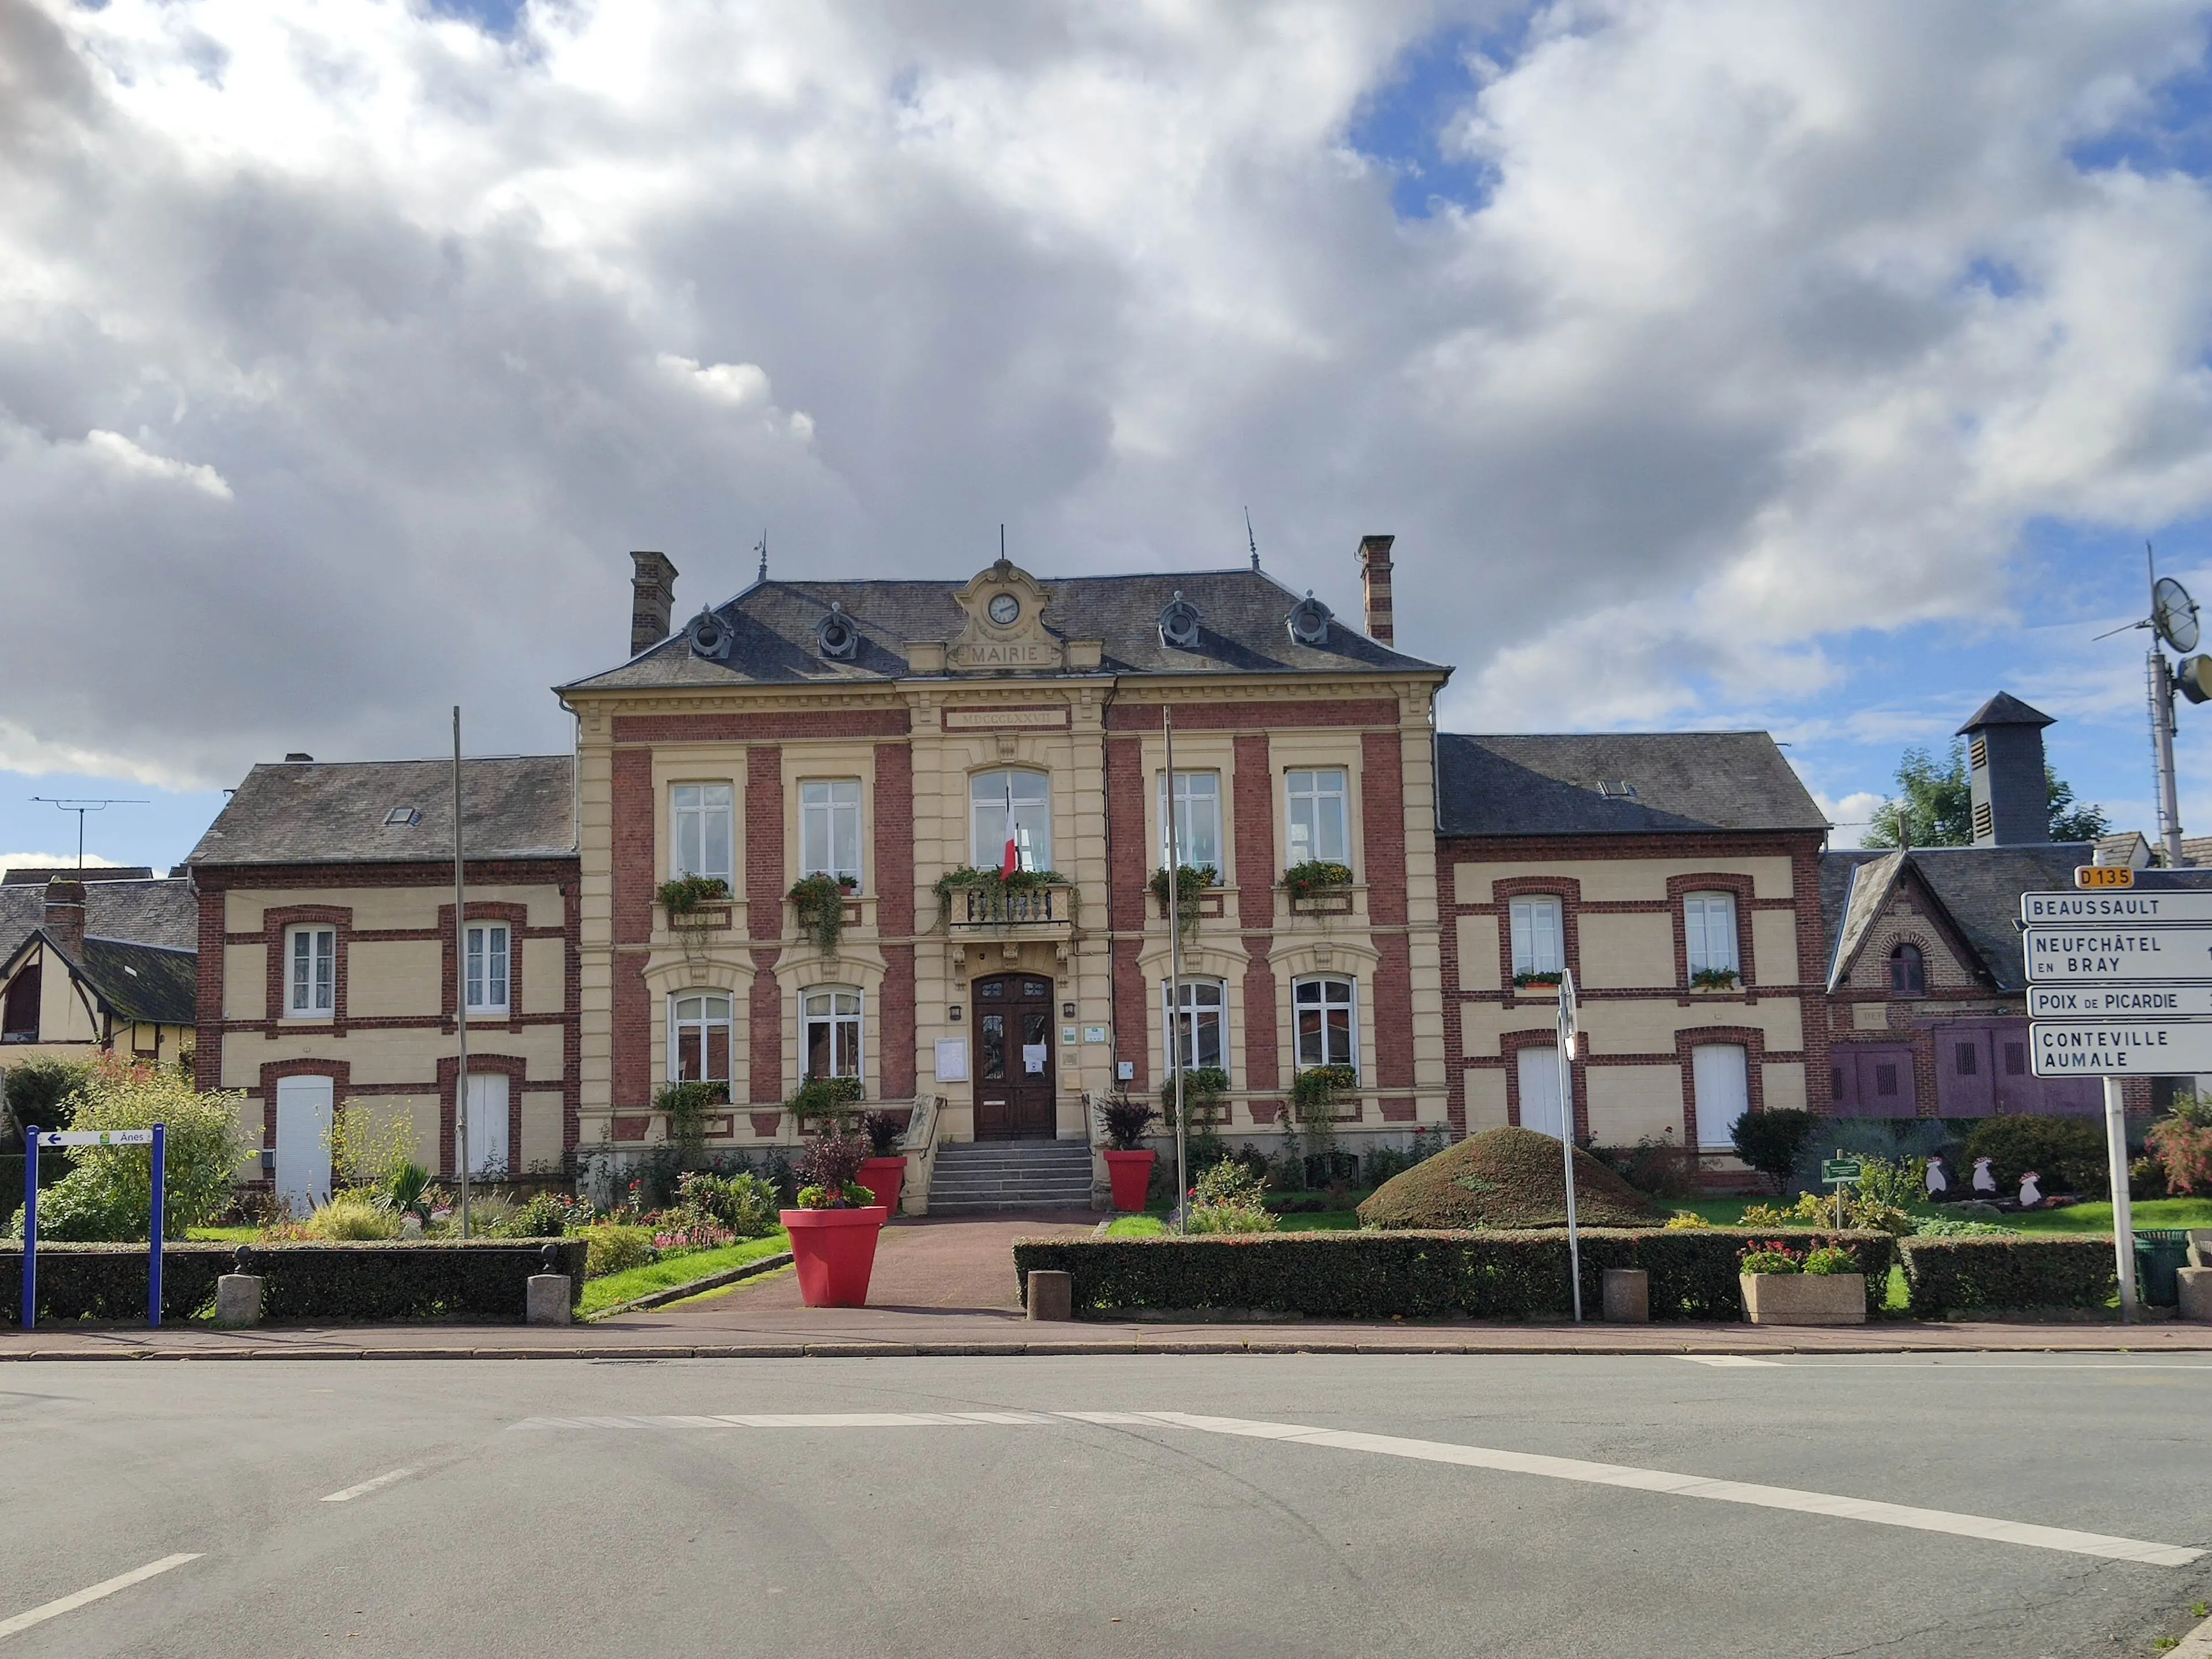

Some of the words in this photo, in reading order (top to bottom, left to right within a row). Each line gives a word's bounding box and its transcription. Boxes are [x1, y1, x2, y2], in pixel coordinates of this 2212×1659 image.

[972, 647, 1037, 662] MAIRIE
[2033, 900, 2159, 915] BEAUSSAULT
[2036, 934, 2161, 952] NEUFCHÂTEL
[2038, 963, 2054, 973] EN
[2068, 957, 2120, 972] BRAY
[2039, 995, 2077, 1009] POIX
[2084, 999, 2099, 1009] DE
[2105, 994, 2178, 1009] PICARDIE
[2043, 1031, 2168, 1047] CONTEVILLE
[2045, 1052, 2127, 1067] AUMALE
[120, 1132, 143, 1141] Ânes
